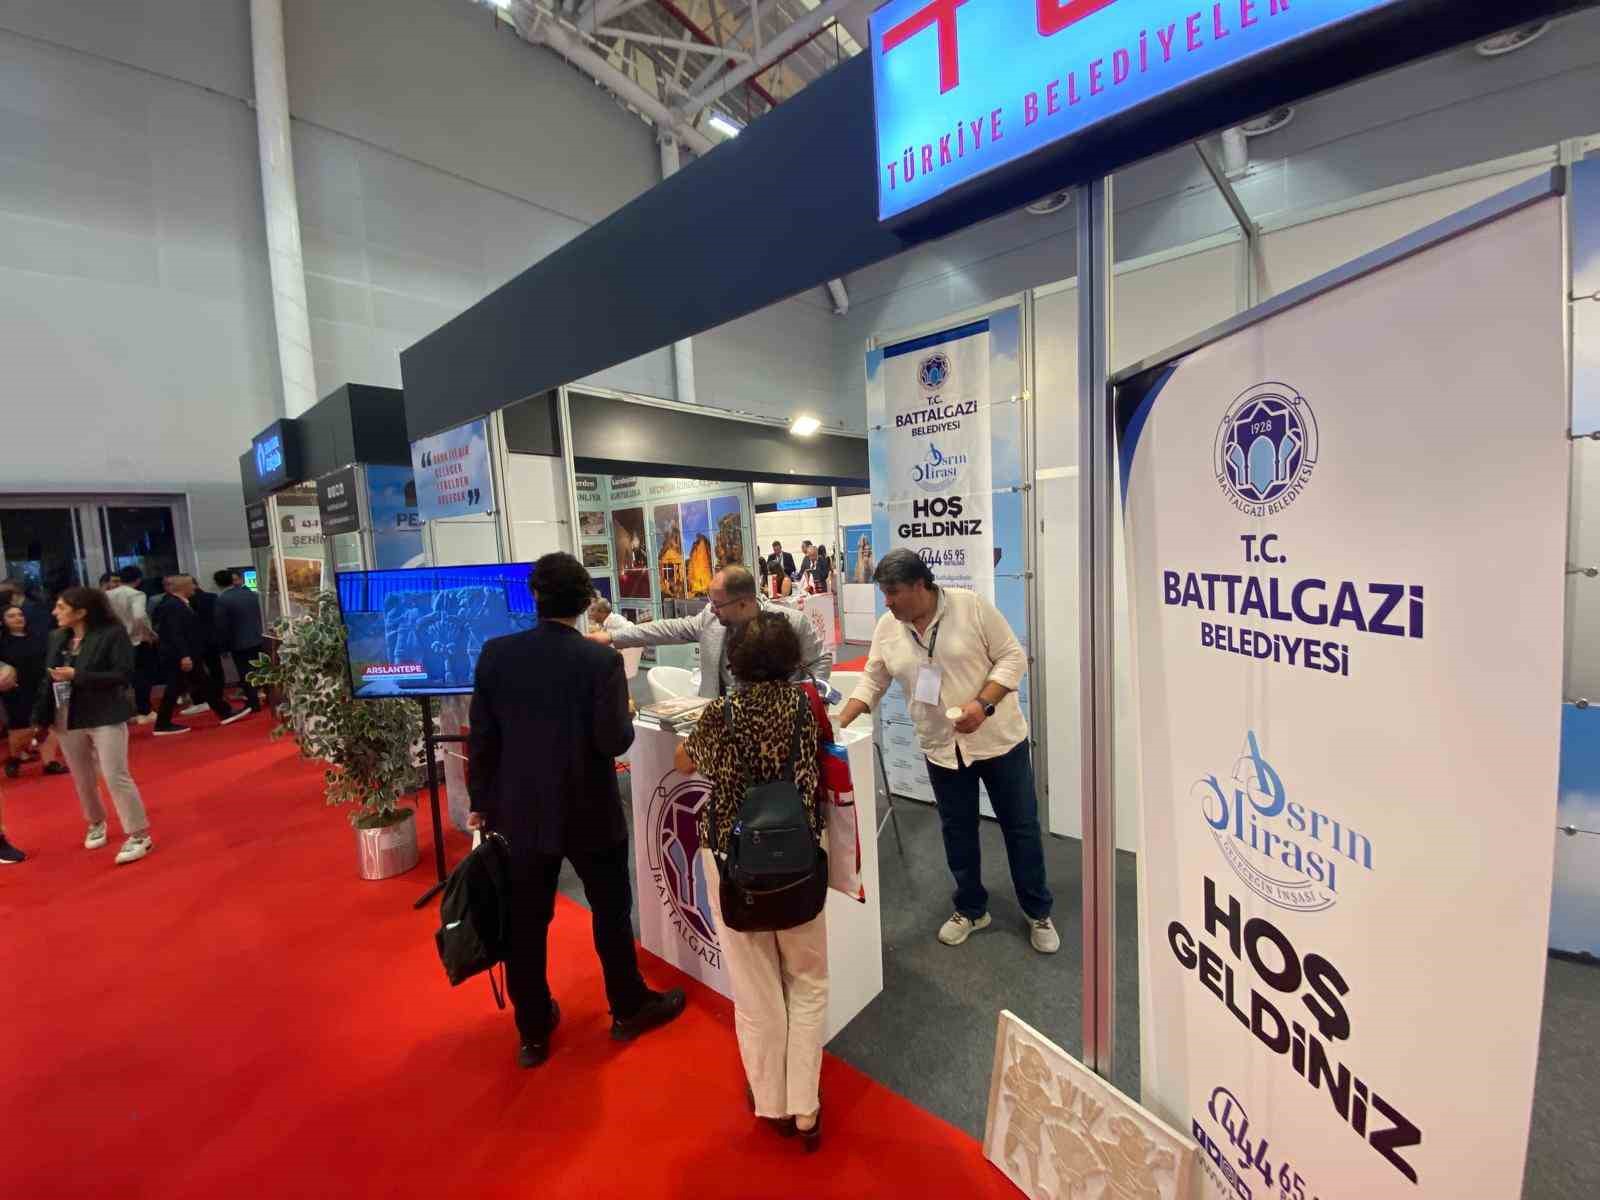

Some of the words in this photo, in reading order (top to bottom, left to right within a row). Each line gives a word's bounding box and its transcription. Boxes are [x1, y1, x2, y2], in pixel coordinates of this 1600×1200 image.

[887, 108, 1004, 190] TÜRKİYE
[896, 401, 978, 427] BATTALGAZİ
[912, 421, 960, 437] BELEDİYESİ
[1250, 420, 1272, 435] 1928
[913, 496, 963, 518] HOŞ
[898, 519, 982, 539] GELDİNİZ
[1240, 533, 1287, 563] T.C.
[1163, 570, 1424, 639] BATTALGAZİ
[1201, 621, 1349, 676] BELEDİYESİ
[366, 665, 422, 674] ARSLANTEPE
[1203, 875, 1350, 1042] HOŞ
[1167, 921, 1422, 1185] GELDİNİZ
[1220, 1098, 1274, 1188] 444
